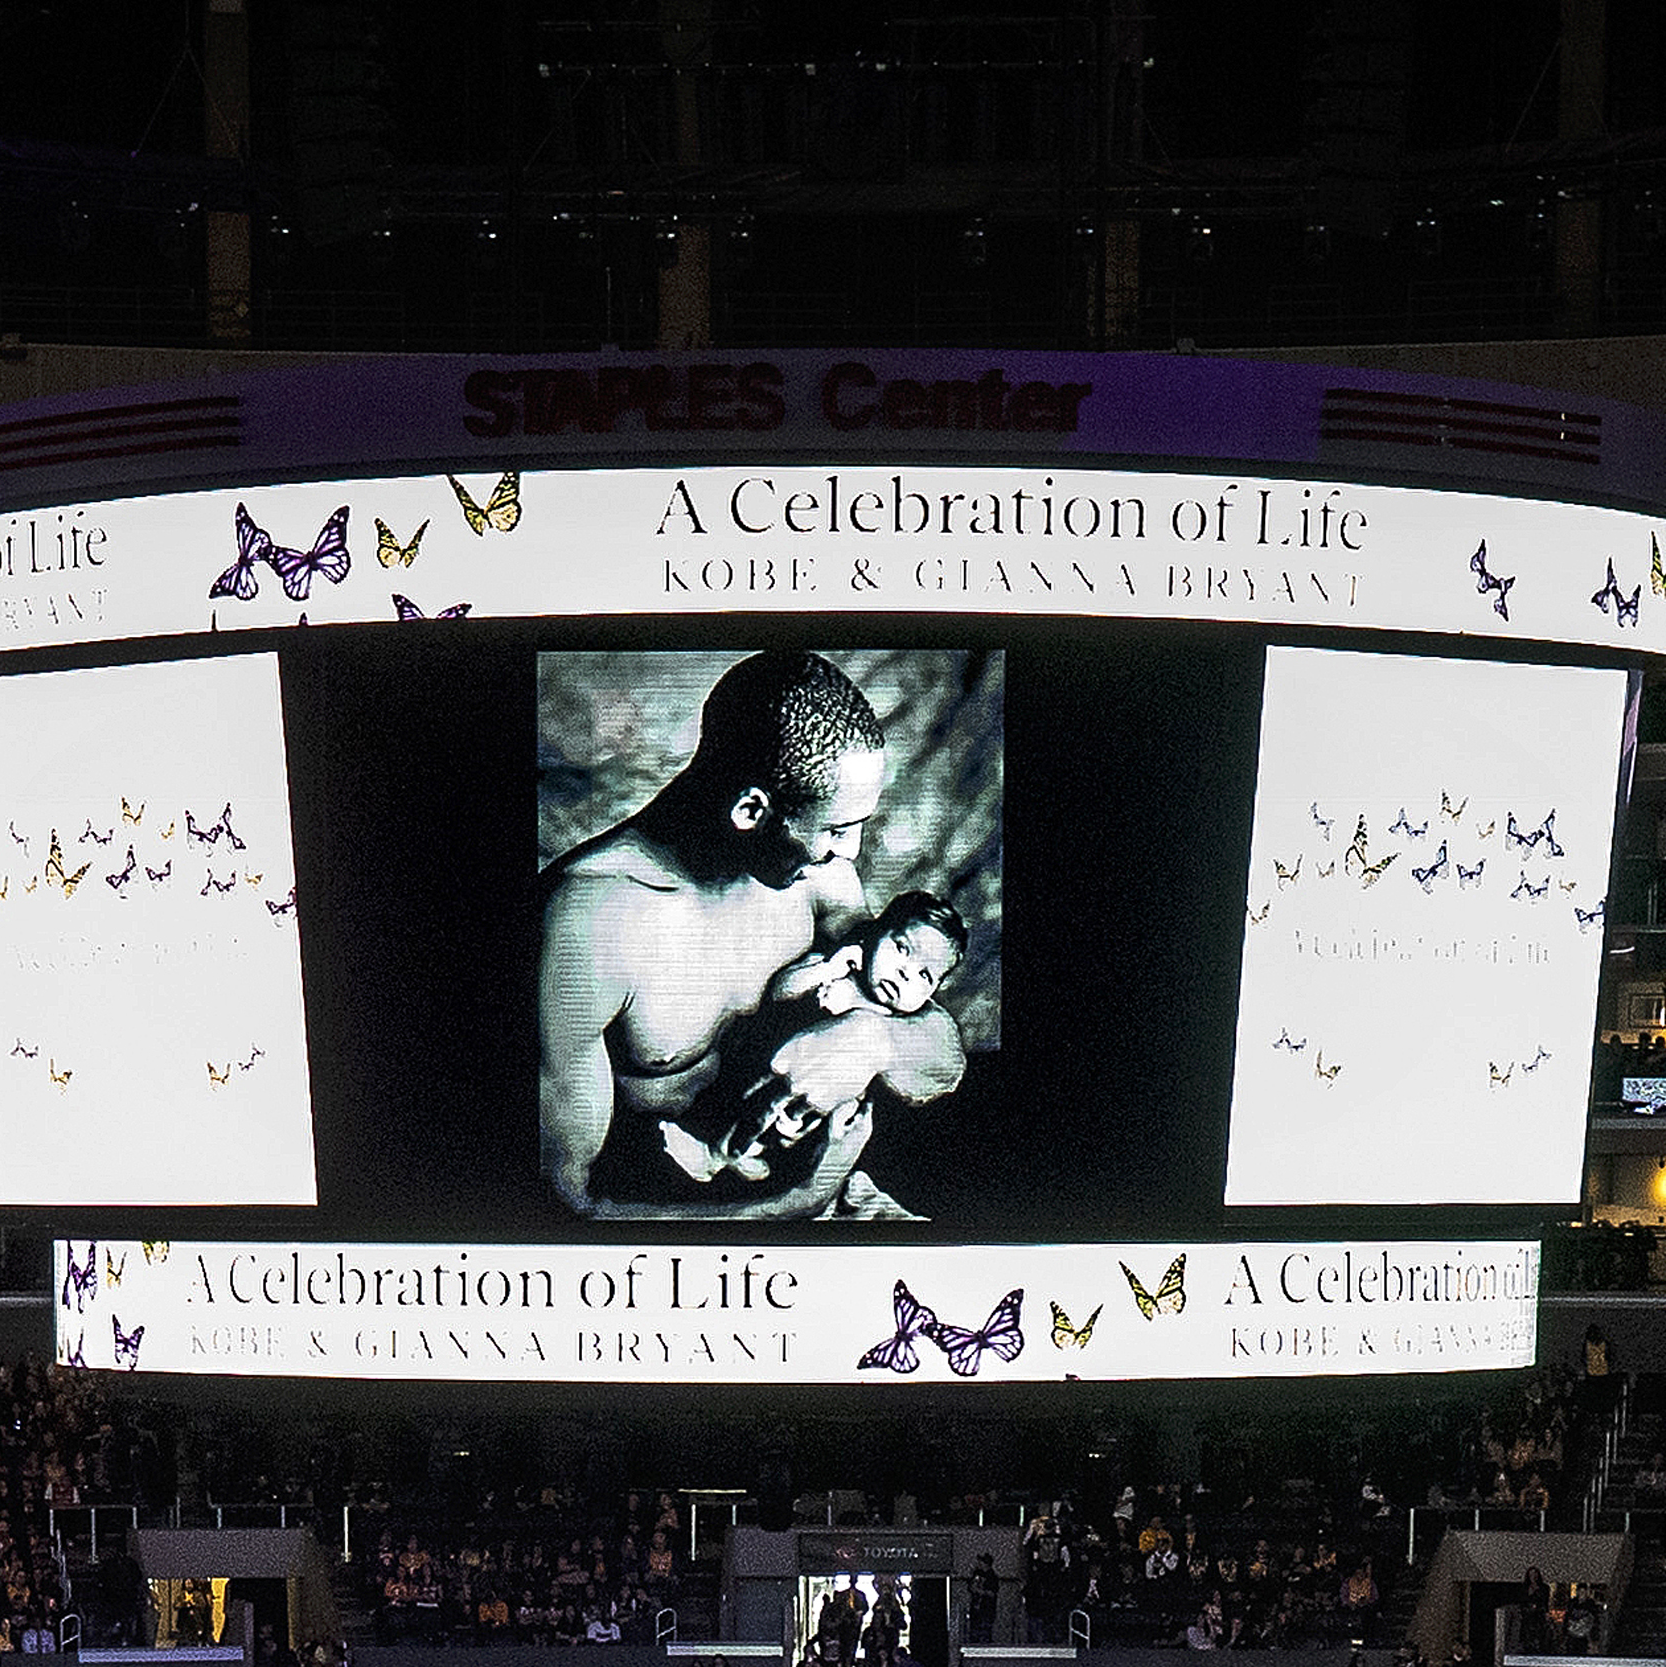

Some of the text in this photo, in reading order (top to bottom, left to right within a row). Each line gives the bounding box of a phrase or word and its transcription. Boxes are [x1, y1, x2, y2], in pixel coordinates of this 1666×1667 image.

[463, 364, 1092, 437] STAPLES Center
[28, 510, 108, 574] Life
[655, 475, 1371, 551] A Celebration of Life
[663, 557, 1367, 608] KOBE & GIANNA BRYANT
[187, 1250, 799, 1312] A Celebration of Life
[1224, 1255, 1263, 1305] A
[1281, 1250, 1496, 1304] Celebration
[575, 1328, 798, 1367] BRYANT
[1232, 1326, 1339, 1357] KOBE
